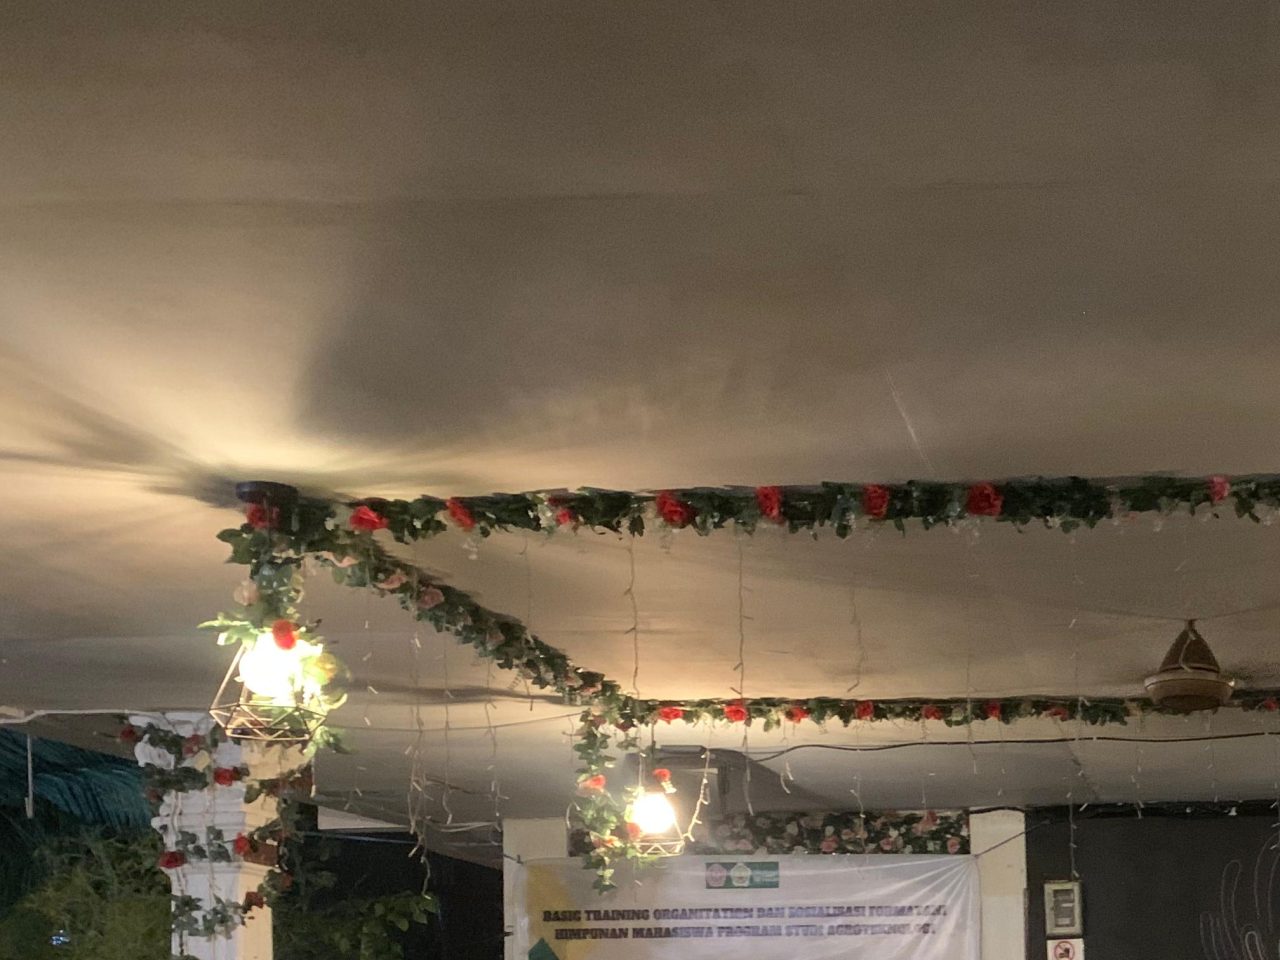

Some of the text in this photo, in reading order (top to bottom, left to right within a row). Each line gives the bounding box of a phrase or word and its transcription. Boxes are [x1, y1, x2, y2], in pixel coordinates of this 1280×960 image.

[543, 909, 581, 922] BASIC
[584, 908, 650, 921] TRAINING
[555, 927, 629, 940] HIMPUNAN
[632, 926, 714, 939] MAHASISWA
[717, 925, 782, 937] PROGRAM
